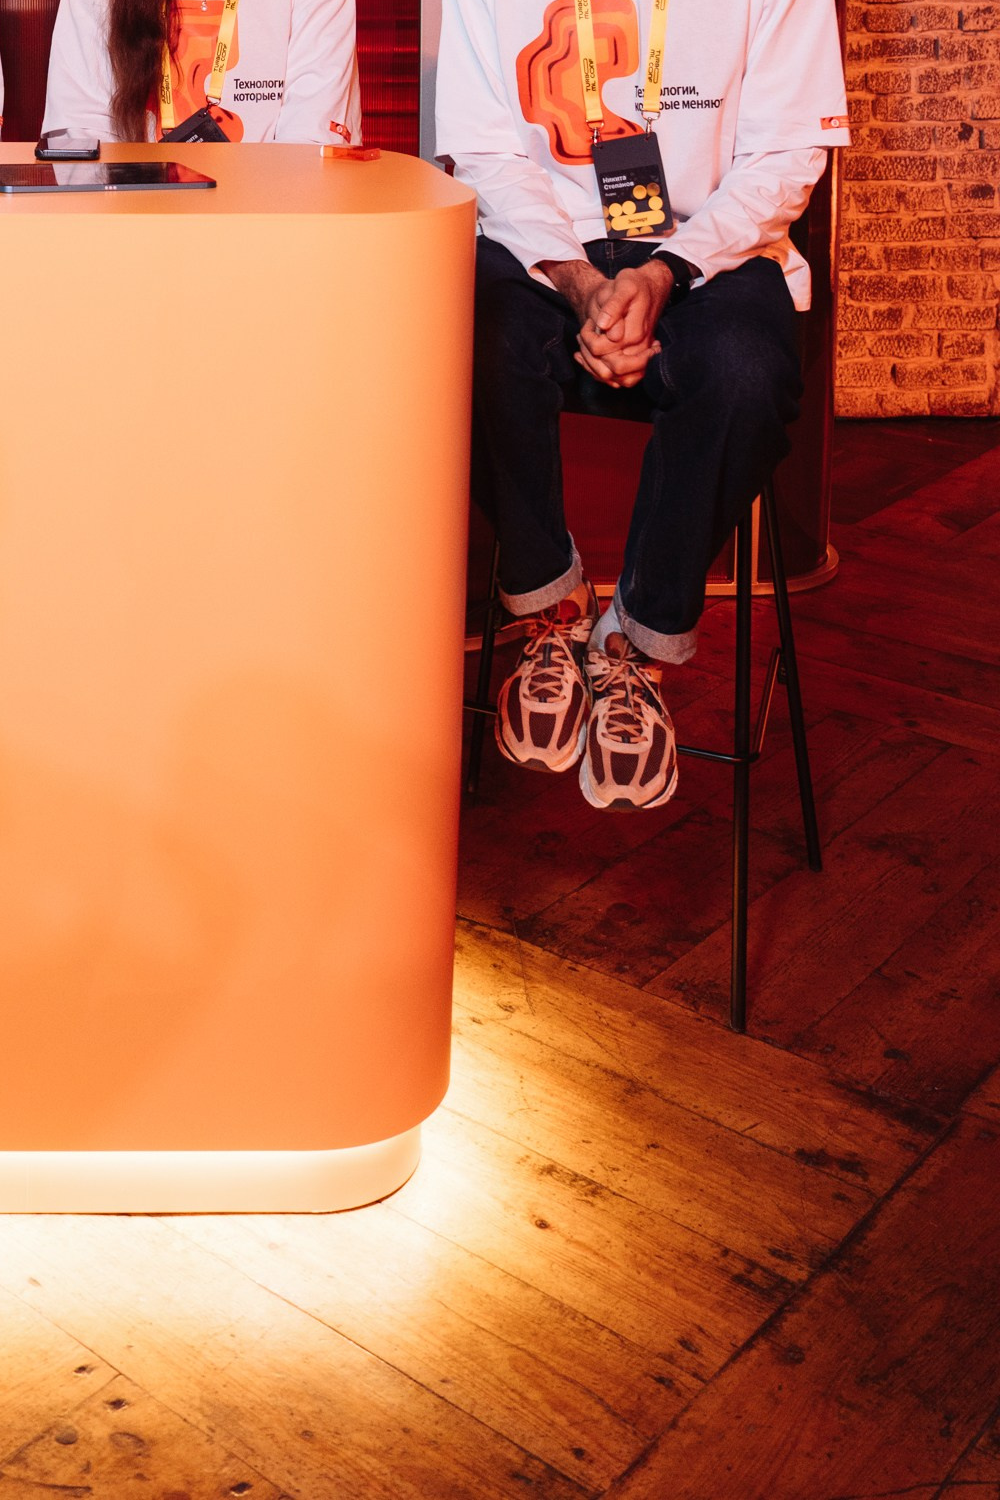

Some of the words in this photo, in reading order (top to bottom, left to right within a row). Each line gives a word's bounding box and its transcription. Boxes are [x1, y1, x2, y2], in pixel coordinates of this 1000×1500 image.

[233, 78, 284, 90] Технологи
[233, 92, 276, 103] которые
[602, 176, 627, 184] Никита
[604, 182, 635, 190] Степанов
